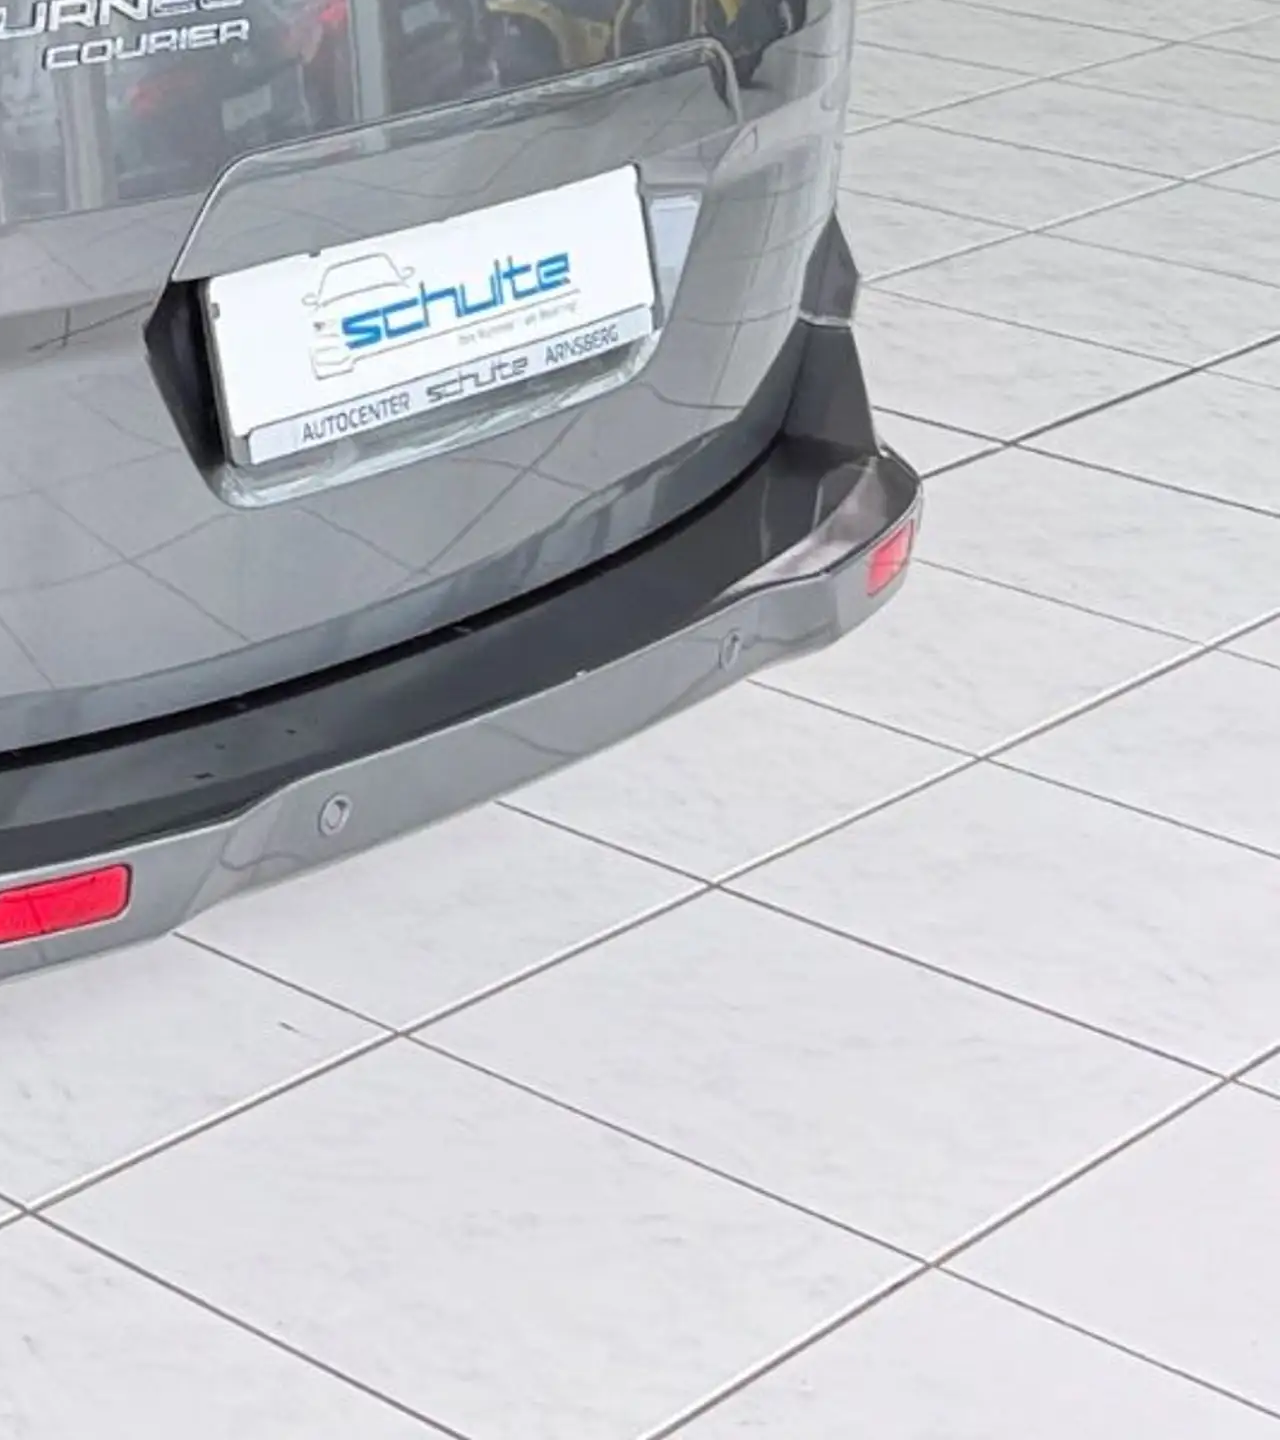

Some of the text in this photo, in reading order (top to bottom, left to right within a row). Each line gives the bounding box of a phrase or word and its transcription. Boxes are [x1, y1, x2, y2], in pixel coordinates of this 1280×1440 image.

[43, 18, 250, 70] COURIER
[341, 251, 571, 350] schulte
[302, 323, 620, 442] AUTOCENTER schulte ARNSBERG
